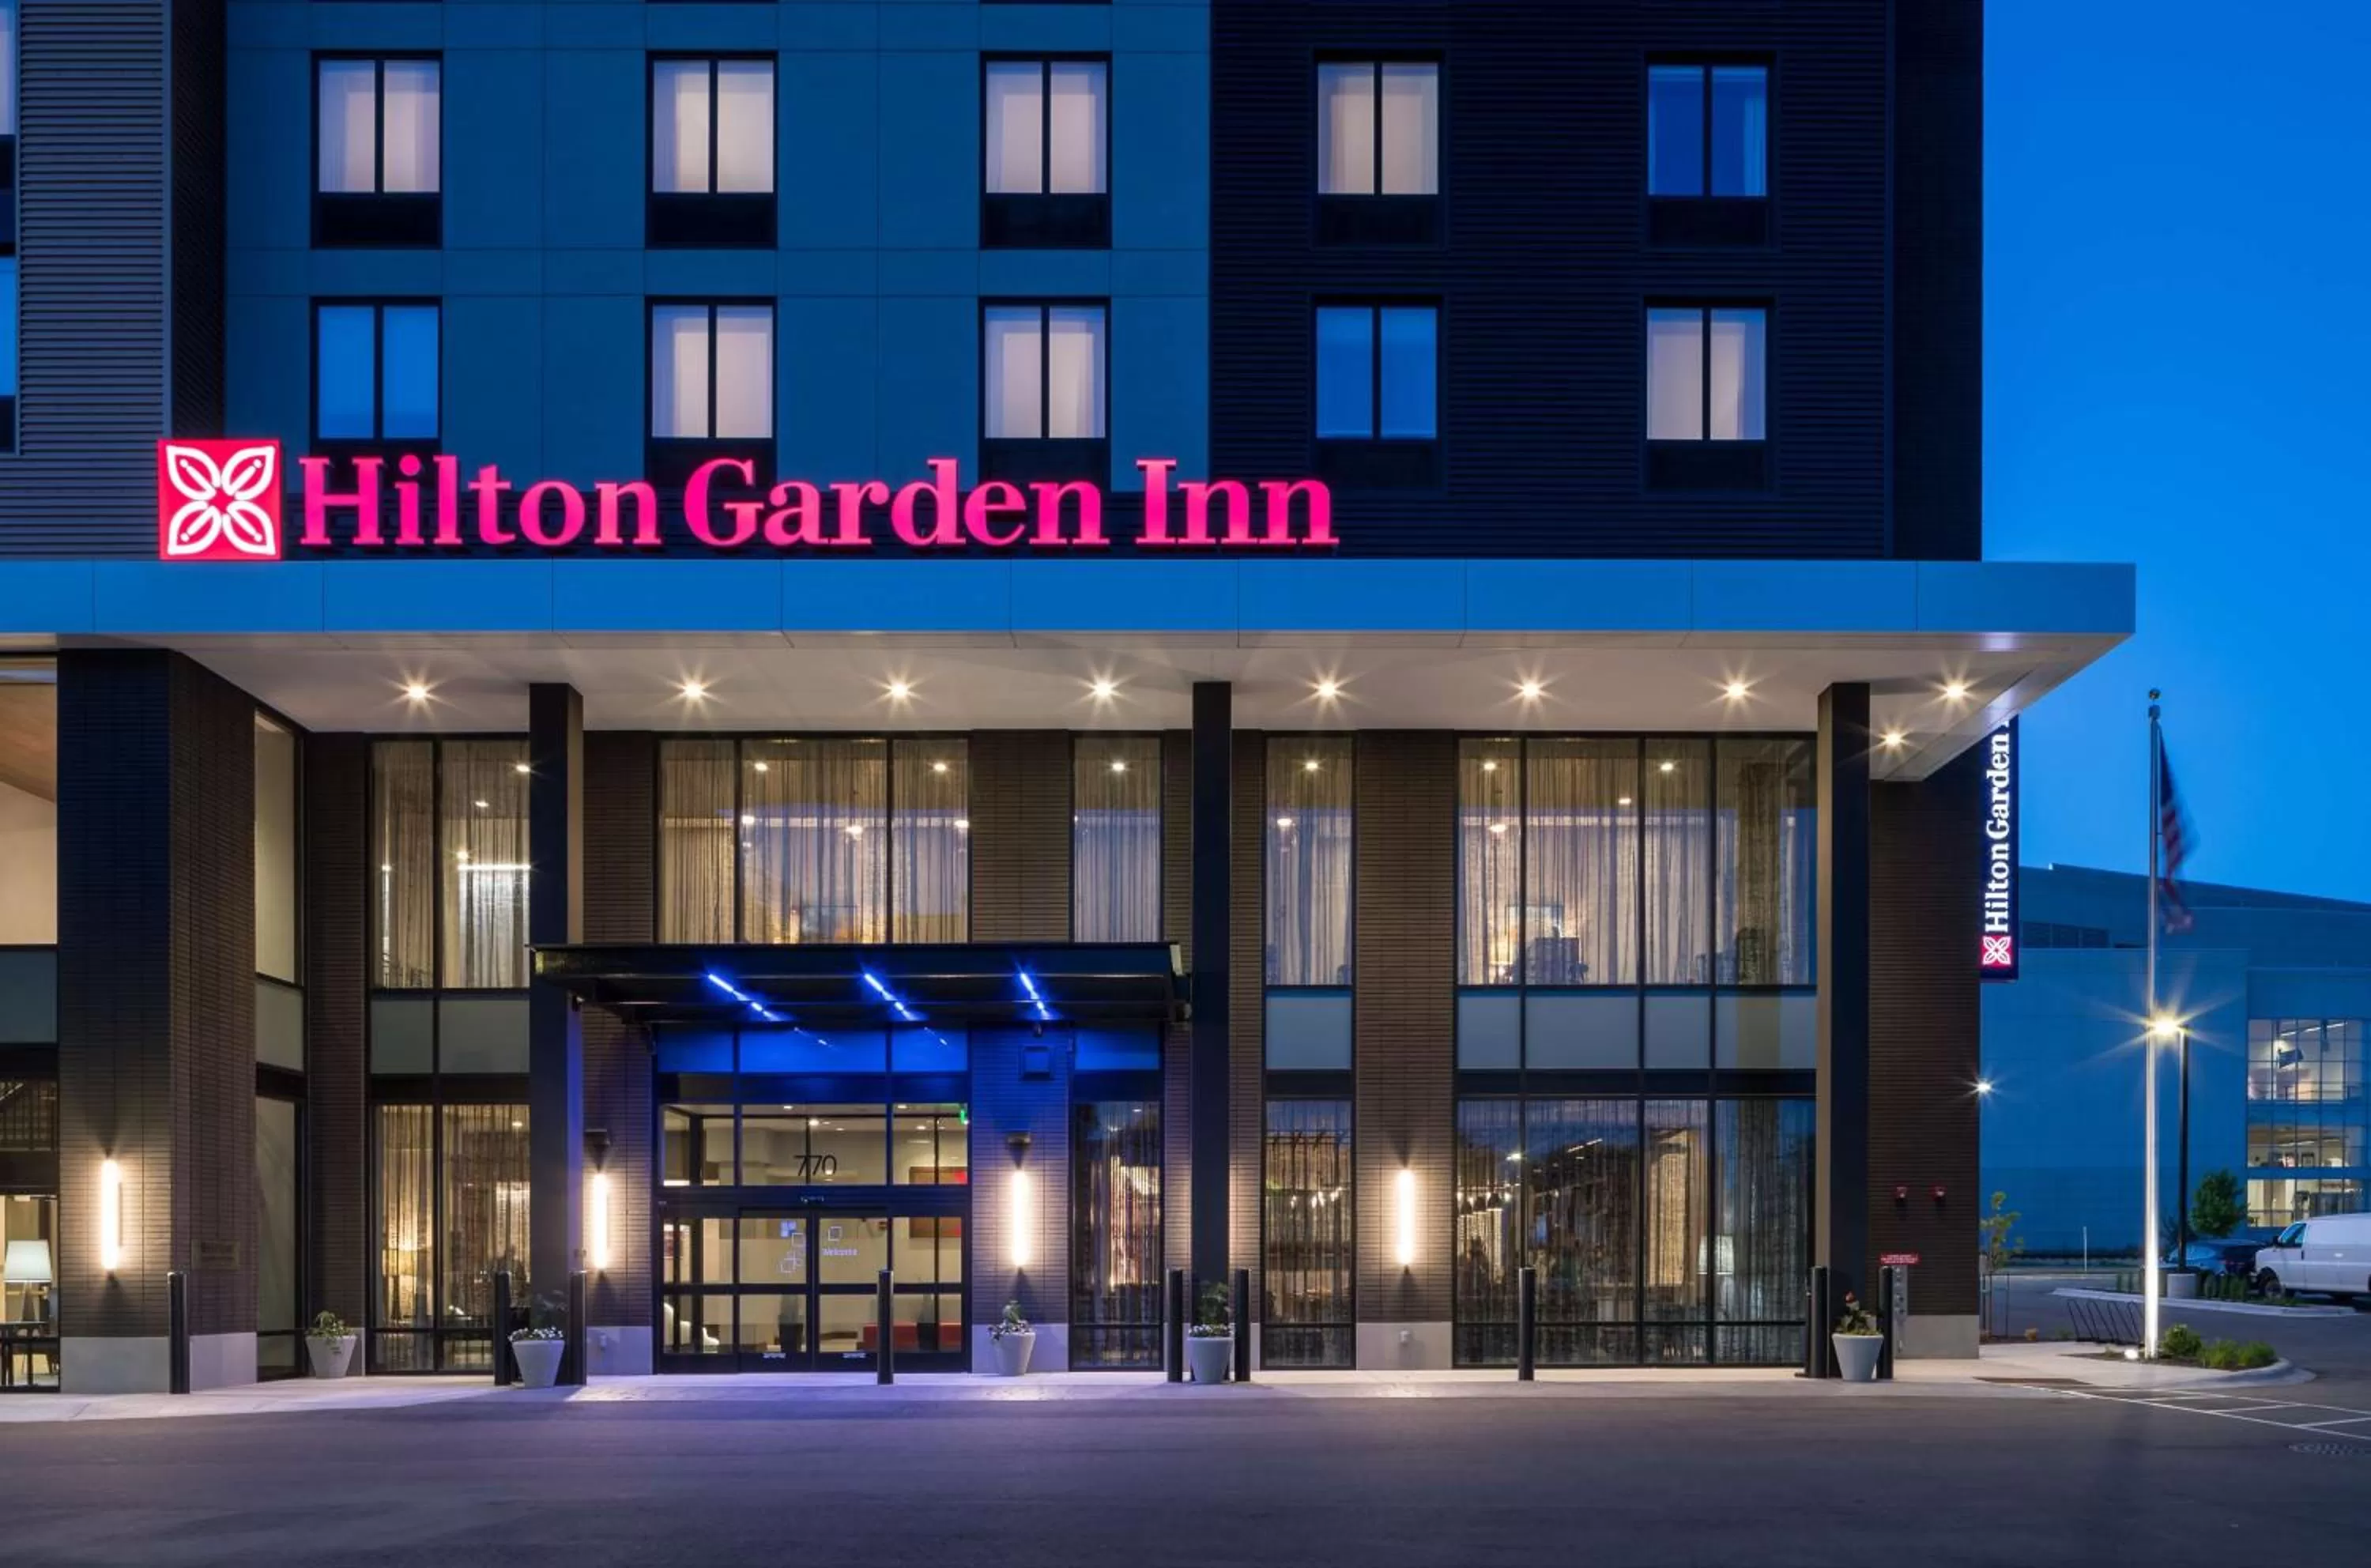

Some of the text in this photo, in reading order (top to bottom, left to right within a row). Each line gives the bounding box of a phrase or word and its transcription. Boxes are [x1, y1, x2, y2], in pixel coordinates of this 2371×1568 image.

[299, 454, 1339, 546] Hilton Garden Inn
[1985, 733, 2010, 839] Garden
[1985, 842, 2009, 933] Hilton
[793, 1155, 837, 1176] 770
